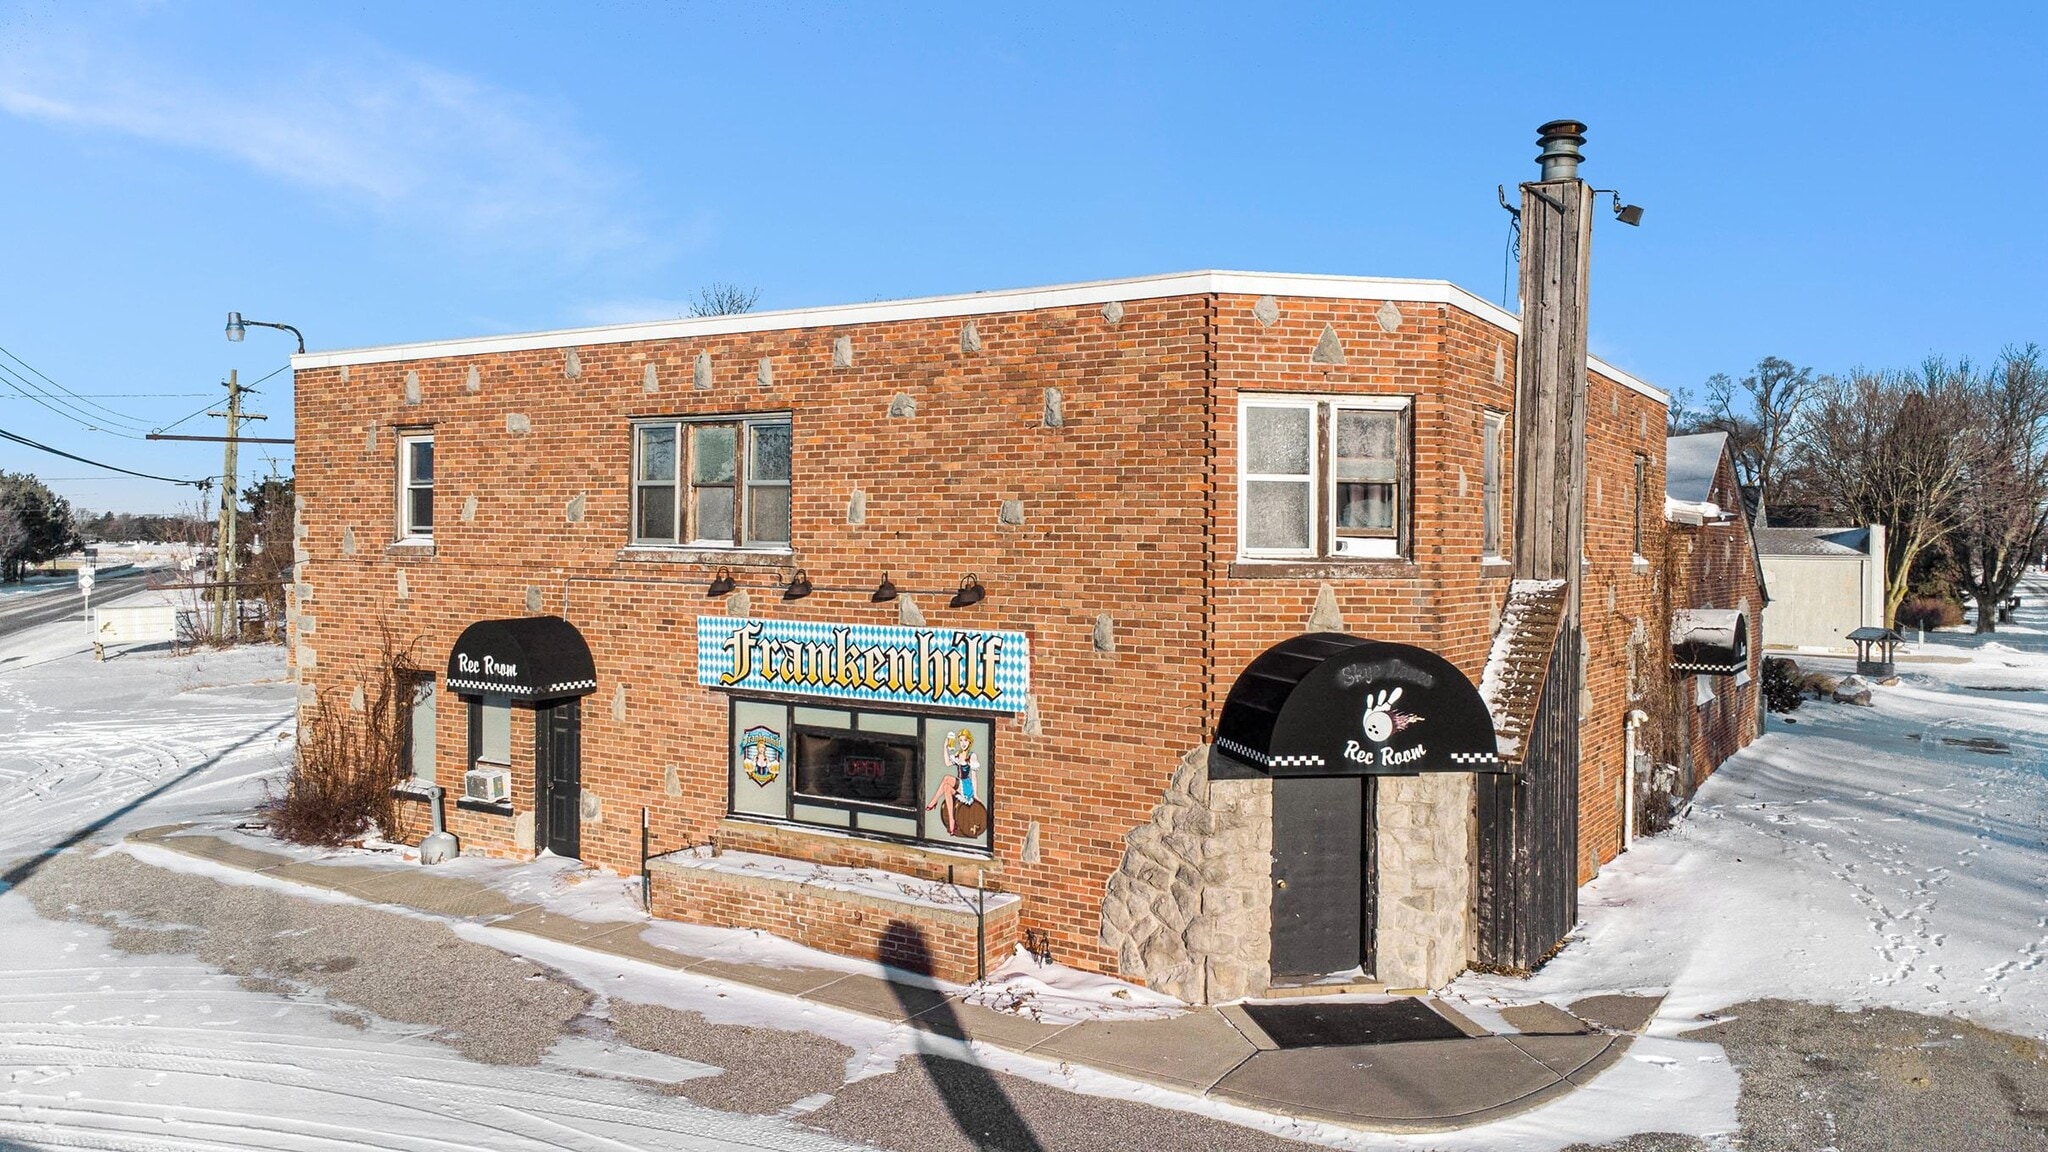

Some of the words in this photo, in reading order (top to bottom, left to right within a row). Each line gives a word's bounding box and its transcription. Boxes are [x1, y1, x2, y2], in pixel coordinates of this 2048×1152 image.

[458, 653, 480, 673] Rec
[483, 655, 518, 677] Room
[720, 620, 1003, 701] Frankenhilf
[1343, 740, 1374, 765] Rec
[1380, 743, 1427, 767] Room
